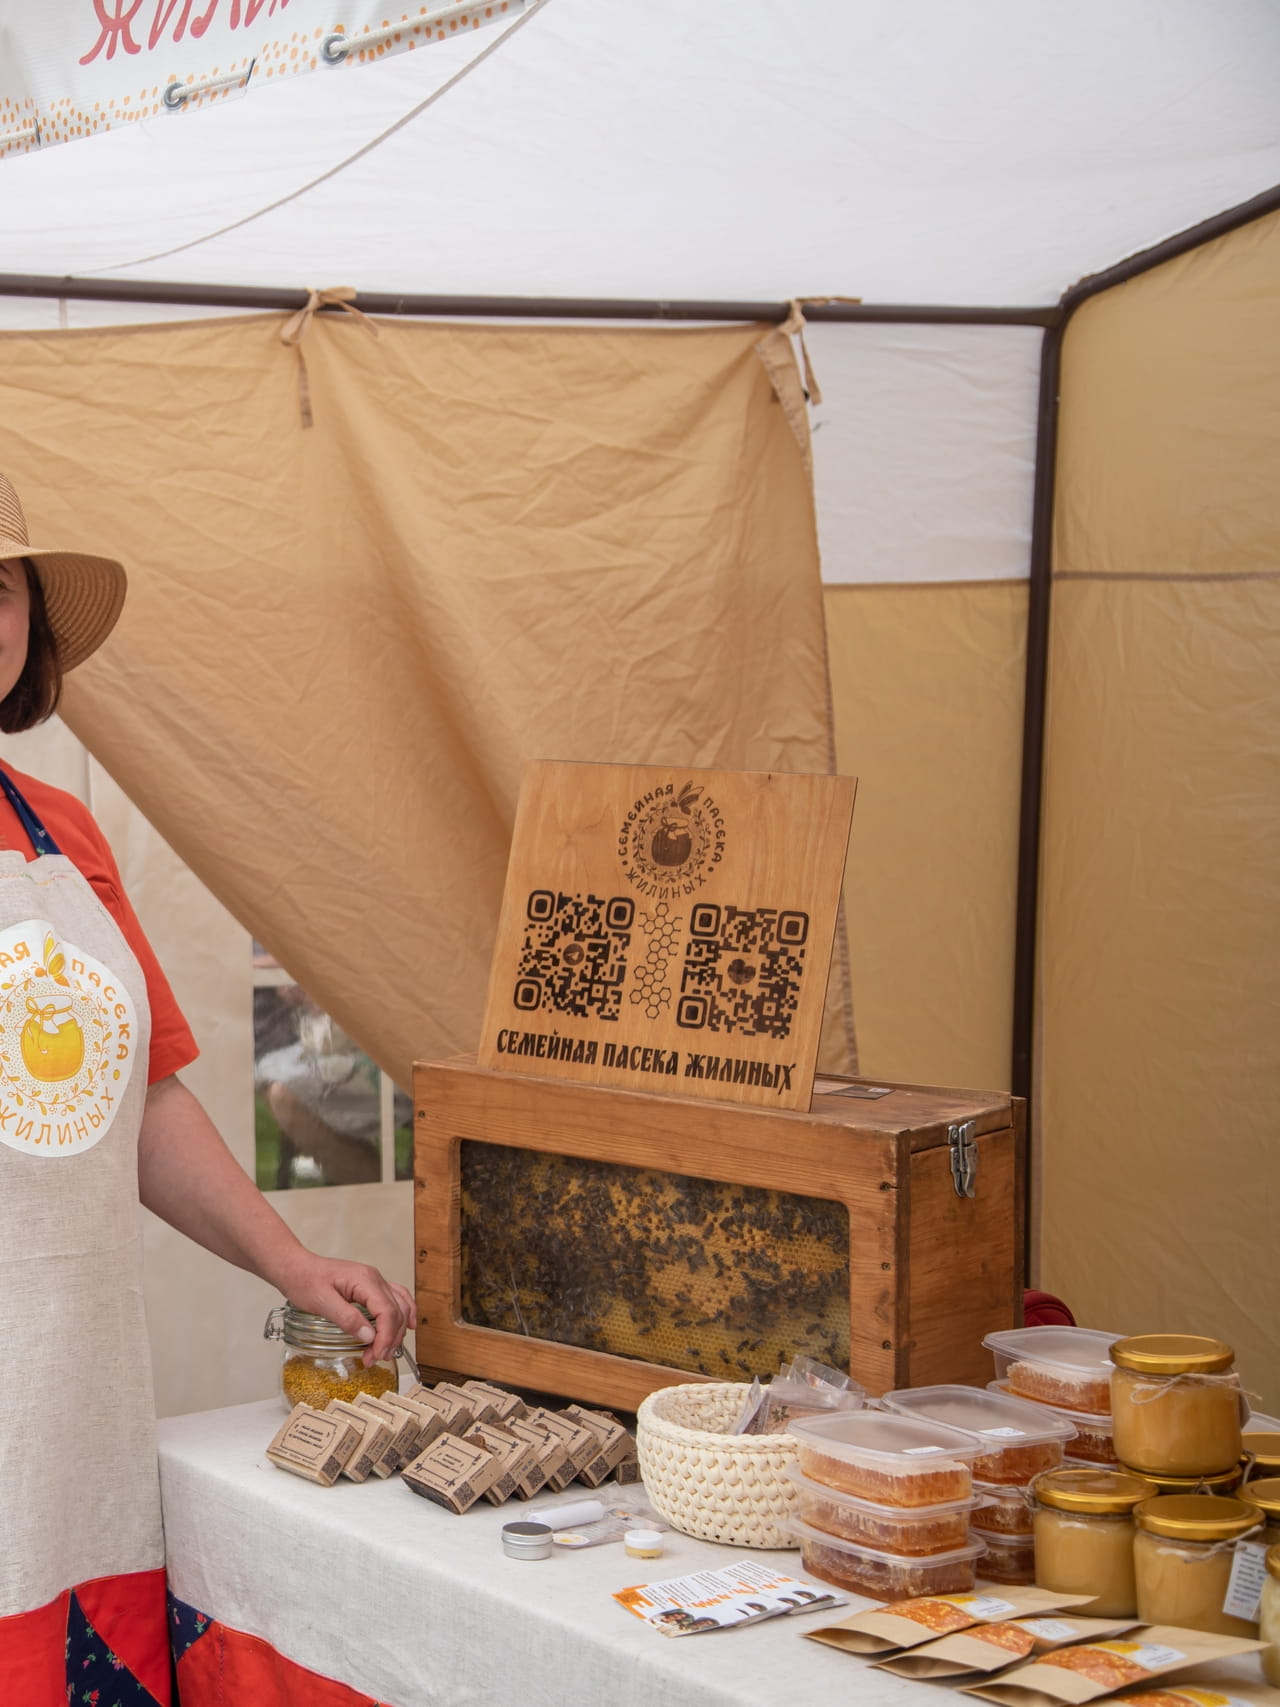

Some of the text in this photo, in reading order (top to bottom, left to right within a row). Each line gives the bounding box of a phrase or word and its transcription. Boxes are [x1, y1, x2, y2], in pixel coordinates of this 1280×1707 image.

[618, 783, 674, 857] СЕМЕЙНАЯ
[702, 796, 726, 863] ПАСЕКА
[625, 867, 707, 899] ЖИЛИНЫХ
[72, 958, 130, 1061] ПАСЕКА
[496, 1028, 797, 1096] СЕМЕЙНАЯ ПАСЕКА ЖИЛИНЫХ
